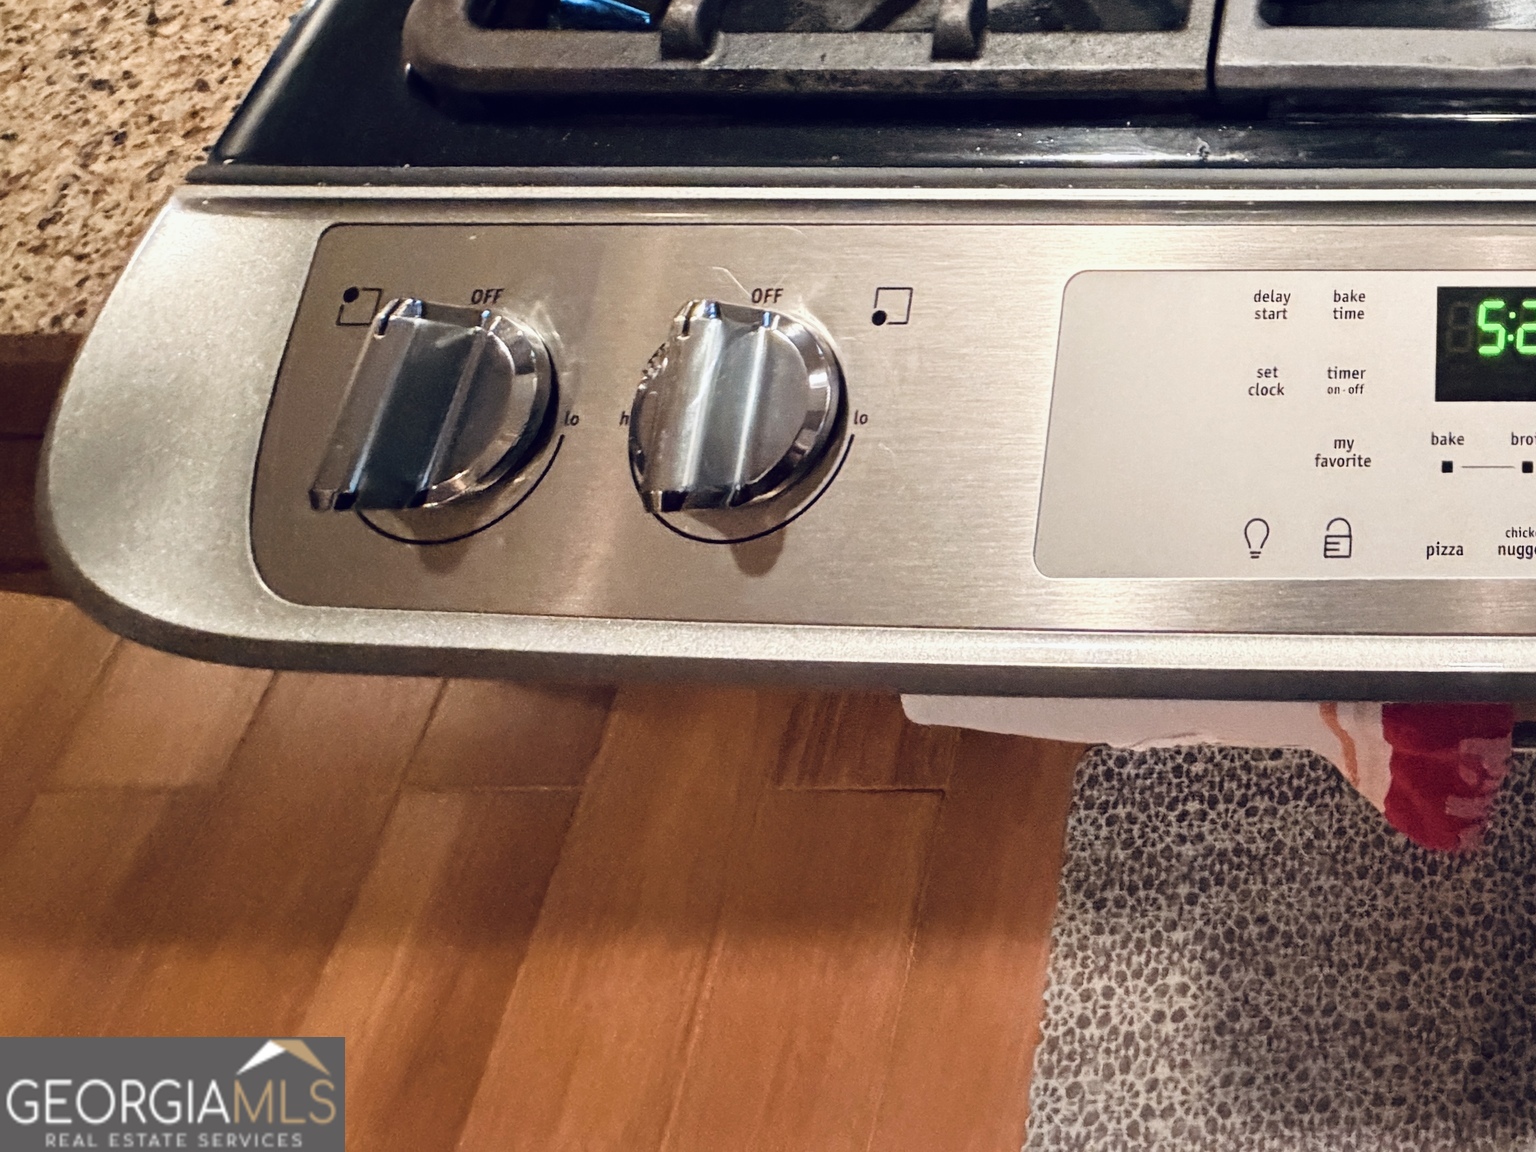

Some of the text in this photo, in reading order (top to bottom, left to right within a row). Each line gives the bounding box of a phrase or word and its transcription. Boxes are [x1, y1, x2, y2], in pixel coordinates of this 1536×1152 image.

[470, 287, 505, 305] OFF
[751, 287, 784, 304] OFF
[1253, 289, 1291, 306] delay
[1333, 289, 1366, 303] bake
[1254, 307, 1288, 320] start
[1332, 307, 1365, 320] time
[1256, 366, 1278, 379] set
[1327, 366, 1367, 380] timer
[1248, 382, 1285, 397] clock
[563, 410, 580, 426] lo
[619, 410, 630, 426] h
[853, 409, 869, 426] lo
[1333, 438, 1355, 453] my
[1431, 431, 1465, 446] bake
[1314, 453, 1372, 468] favorite
[1426, 541, 1464, 558] pizza
